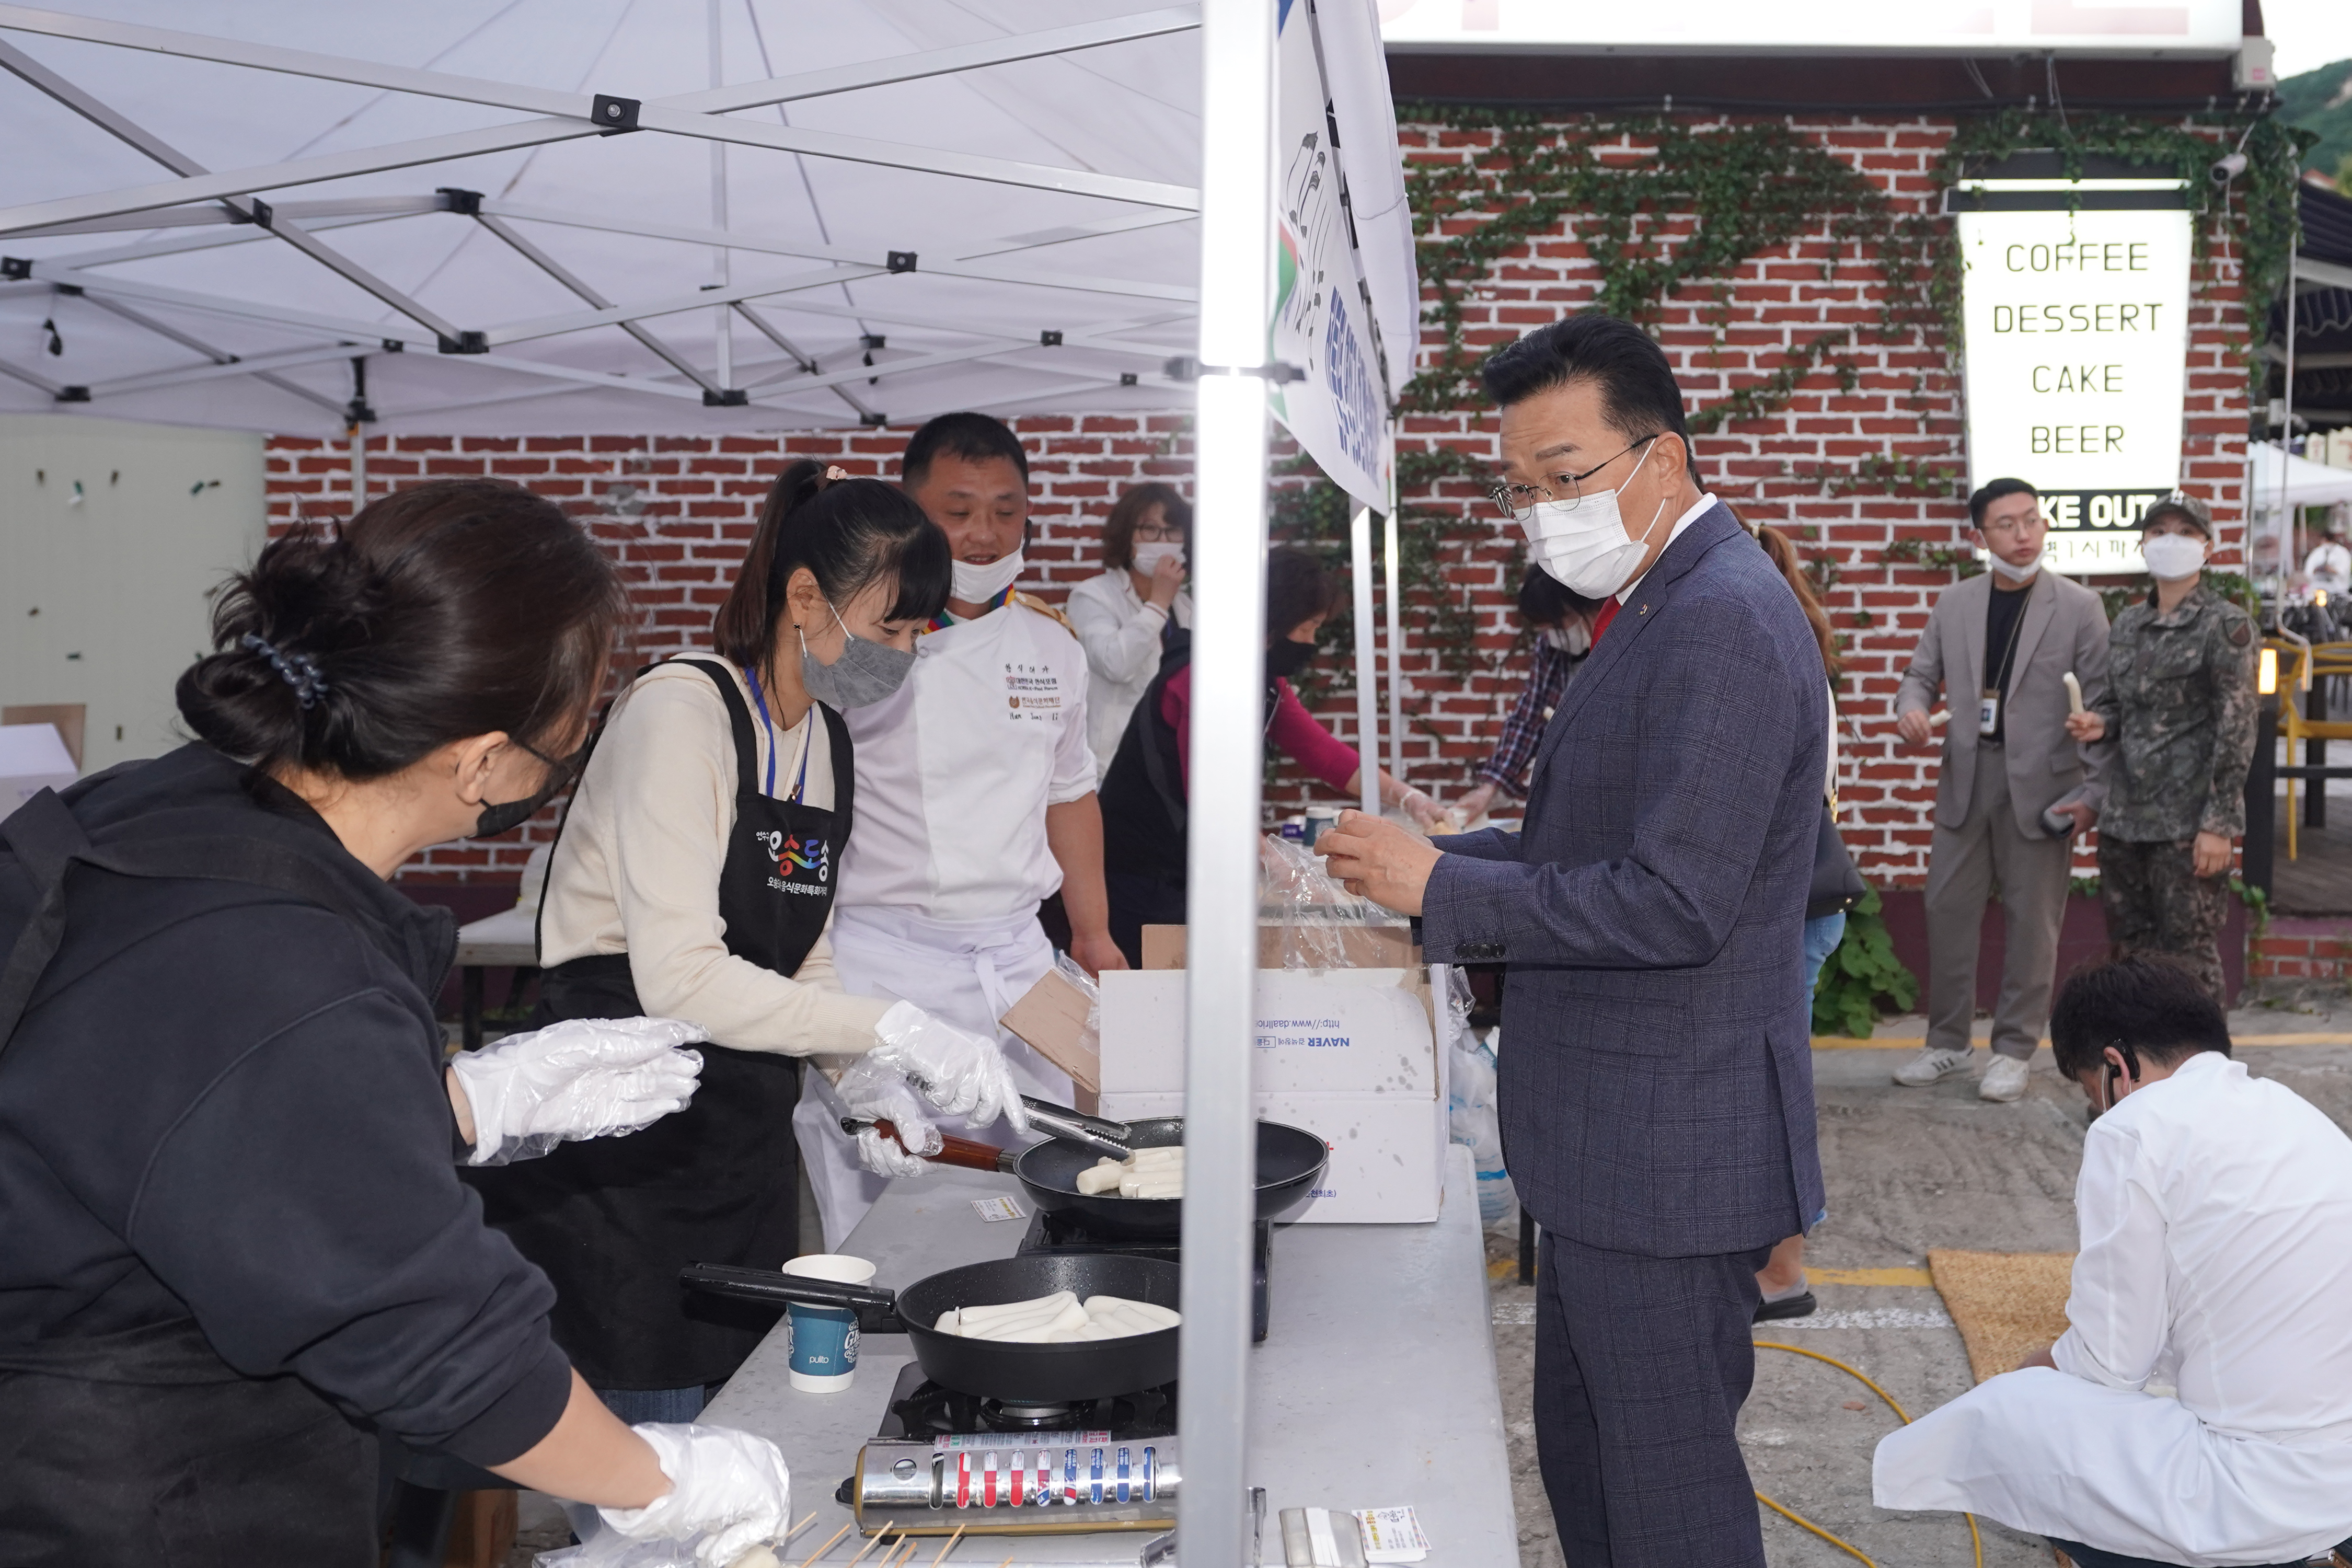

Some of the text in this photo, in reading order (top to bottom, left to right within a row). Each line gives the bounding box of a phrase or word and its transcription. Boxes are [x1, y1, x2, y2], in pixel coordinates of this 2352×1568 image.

[2006, 243, 2149, 272] COFFEE
[1993, 303, 2163, 333] DESSERT
[2033, 365, 2124, 393] CAKE
[2032, 425, 2125, 454] BEER
[2089, 494, 2158, 528] OUT
[1307, 1037, 1350, 1047] NAVER
[1306, 1190, 1336, 1198] 천최초)
[809, 1355, 829, 1364] pulito
